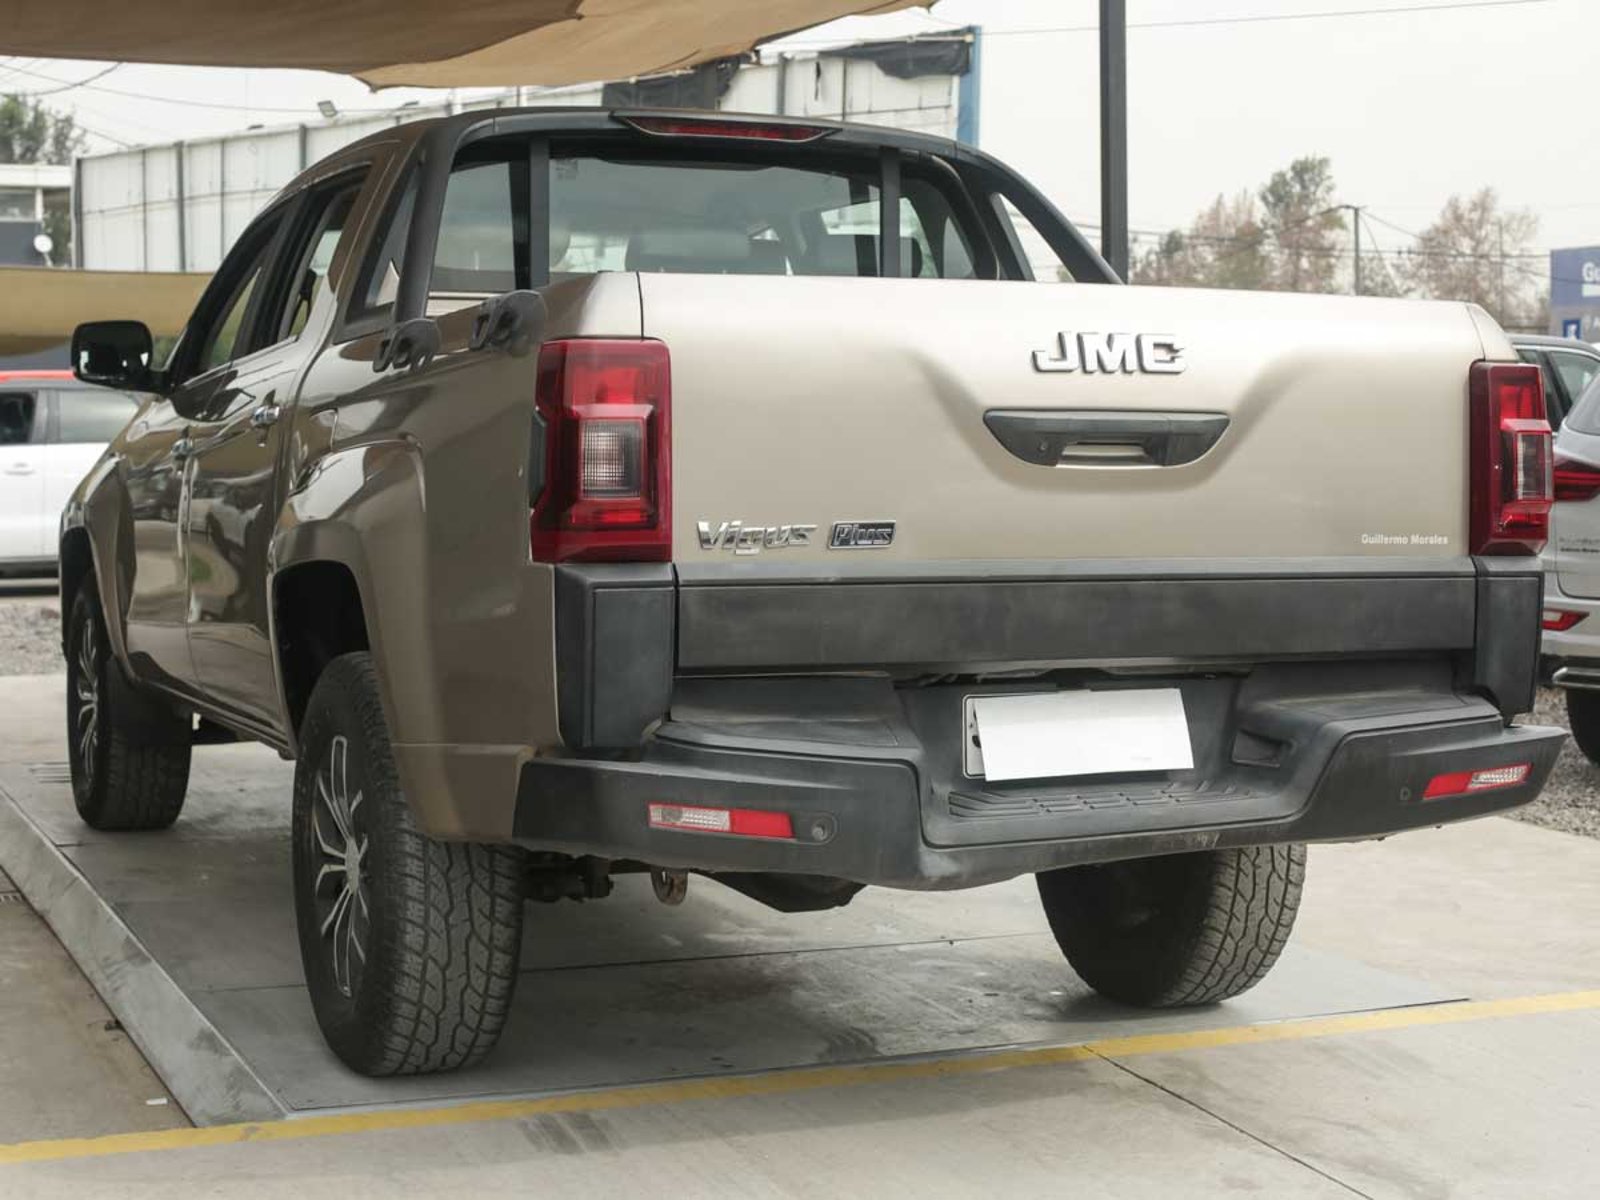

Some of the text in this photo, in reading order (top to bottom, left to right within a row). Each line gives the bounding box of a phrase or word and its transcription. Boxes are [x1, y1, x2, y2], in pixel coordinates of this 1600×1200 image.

[1032, 331, 1185, 374] JMC
[697, 519, 892, 555] Vigus Plus
[1361, 533, 1448, 545] Guillermo Morales
